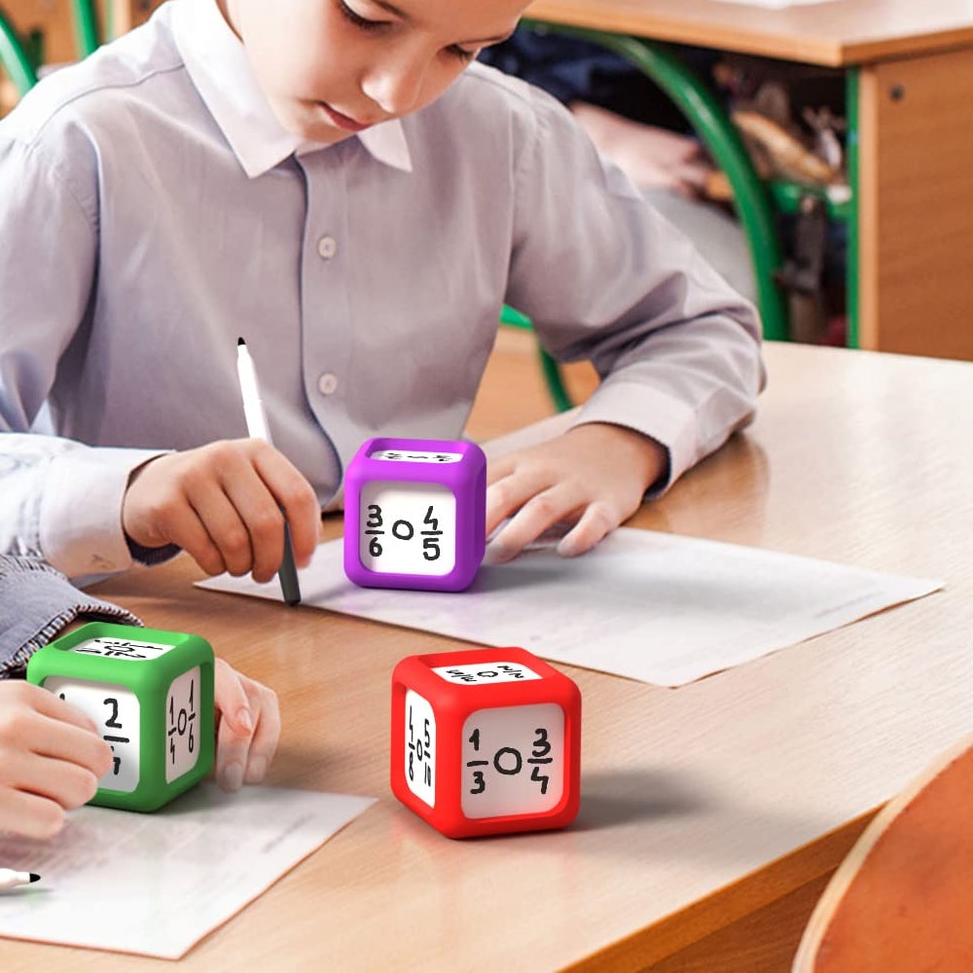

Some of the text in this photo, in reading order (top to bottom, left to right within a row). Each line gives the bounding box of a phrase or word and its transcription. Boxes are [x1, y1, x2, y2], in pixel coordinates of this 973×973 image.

[366, 504, 383, 528] 3
[368, 536, 441, 561] 6 5
[103, 697, 123, 729] 2
[531, 728, 552, 758] 3
